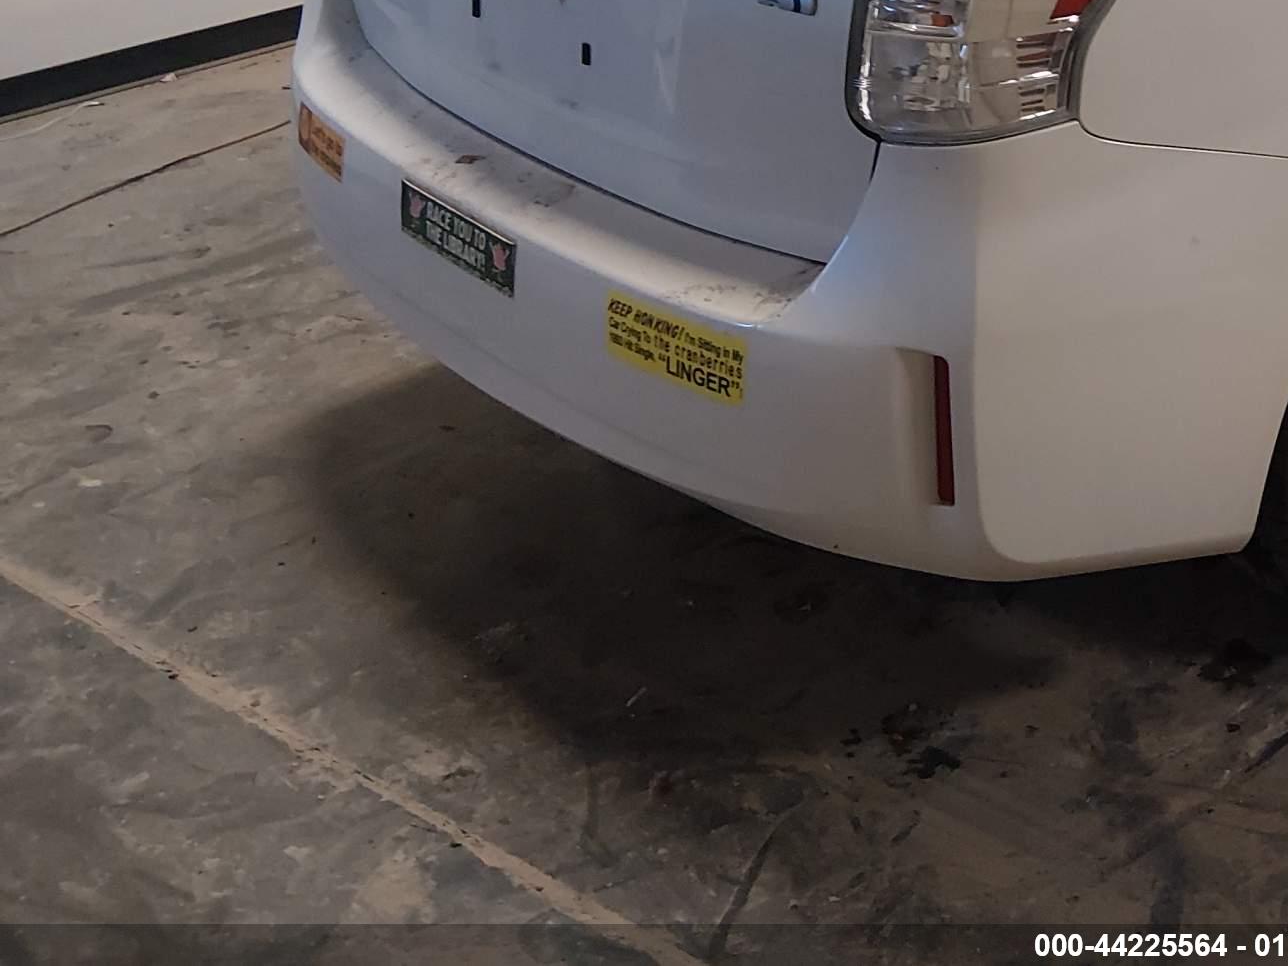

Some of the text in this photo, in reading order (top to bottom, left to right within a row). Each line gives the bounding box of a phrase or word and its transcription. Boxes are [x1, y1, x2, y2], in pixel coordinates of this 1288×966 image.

[425, 219, 443, 246] THE
[426, 201, 487, 251] RACE YOU TO
[608, 297, 633, 318] KEEP
[634, 309, 685, 341] HONKING!
[608, 316, 621, 331] Car
[620, 320, 642, 343] Crying
[654, 335, 671, 354] the
[674, 344, 743, 380] cranberries
